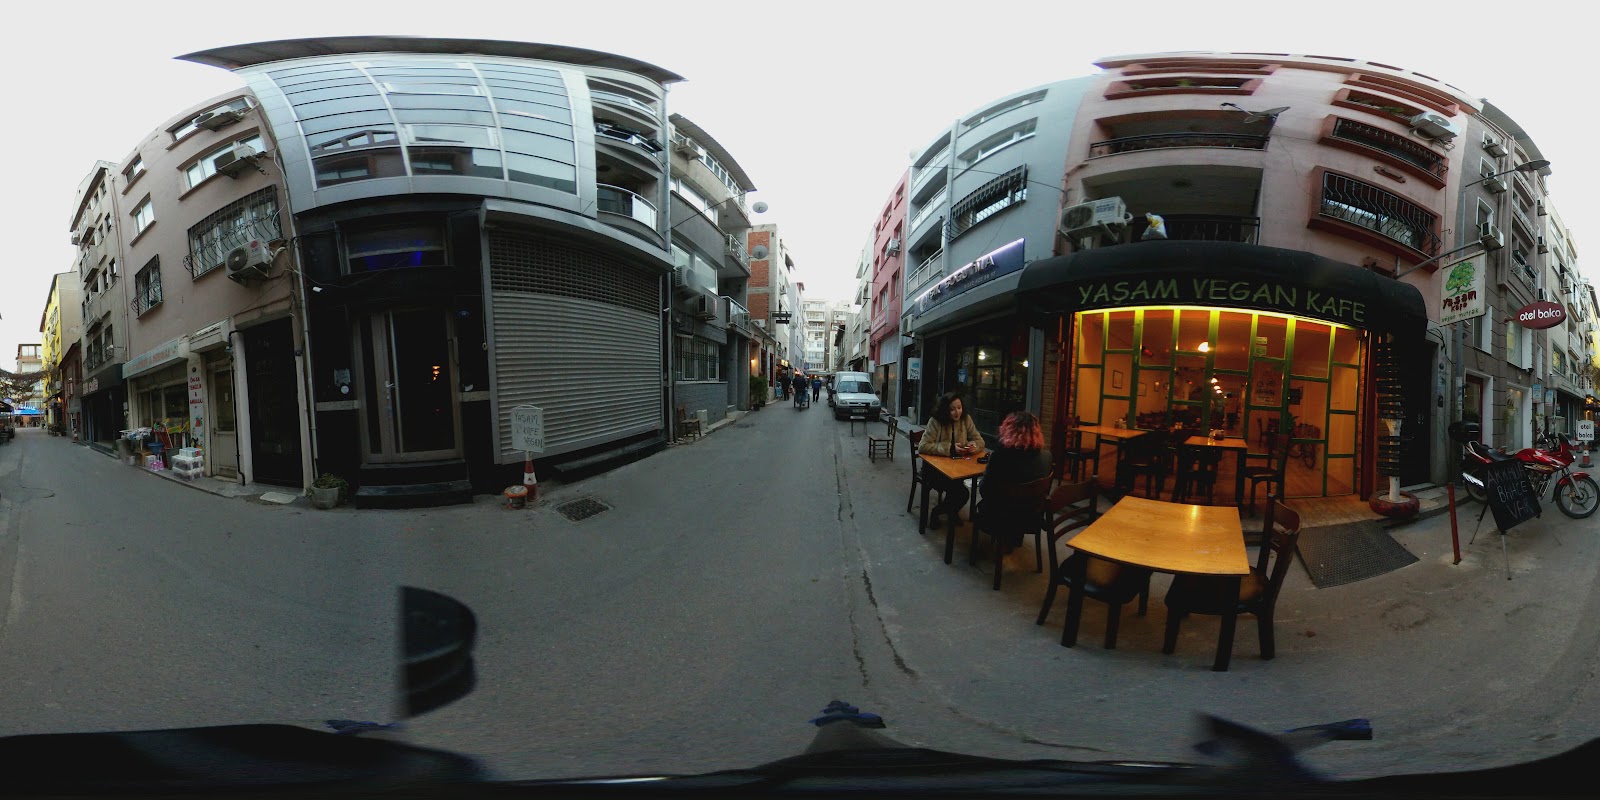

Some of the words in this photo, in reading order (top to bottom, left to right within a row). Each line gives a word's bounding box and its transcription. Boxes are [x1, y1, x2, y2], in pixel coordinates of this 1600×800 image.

[1079, 278, 1179, 305] YAŞAM
[1193, 278, 1297, 307] VEGAN
[1306, 290, 1367, 322] KAFE
[1519, 309, 1536, 321] otel
[1537, 307, 1561, 320] balca
